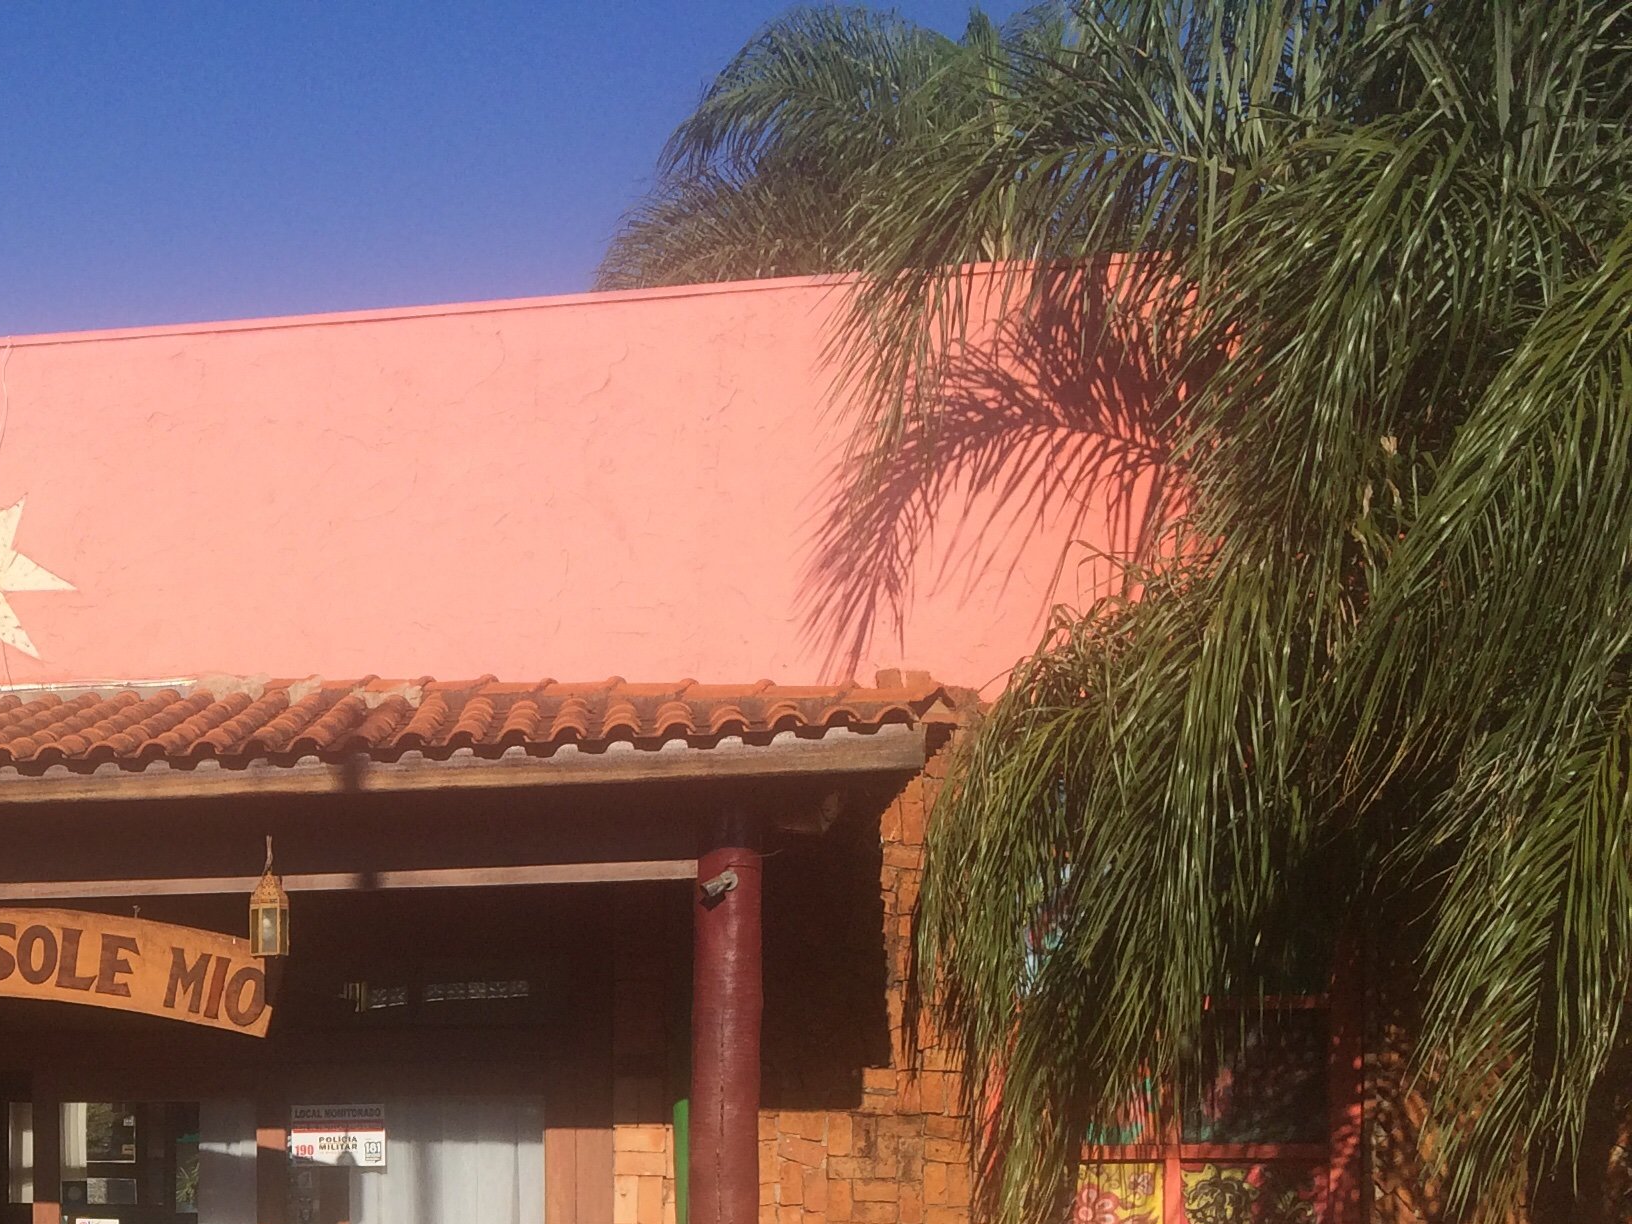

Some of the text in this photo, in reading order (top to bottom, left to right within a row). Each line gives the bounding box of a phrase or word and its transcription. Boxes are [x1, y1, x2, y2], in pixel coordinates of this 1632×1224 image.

[162, 945, 267, 1027] MIO
[294, 1107, 381, 1119] LOCAL MONITORADO
[295, 1144, 314, 1156] 190
[318, 1143, 358, 1151] MILITAR
[364, 1141, 381, 1154] 181
